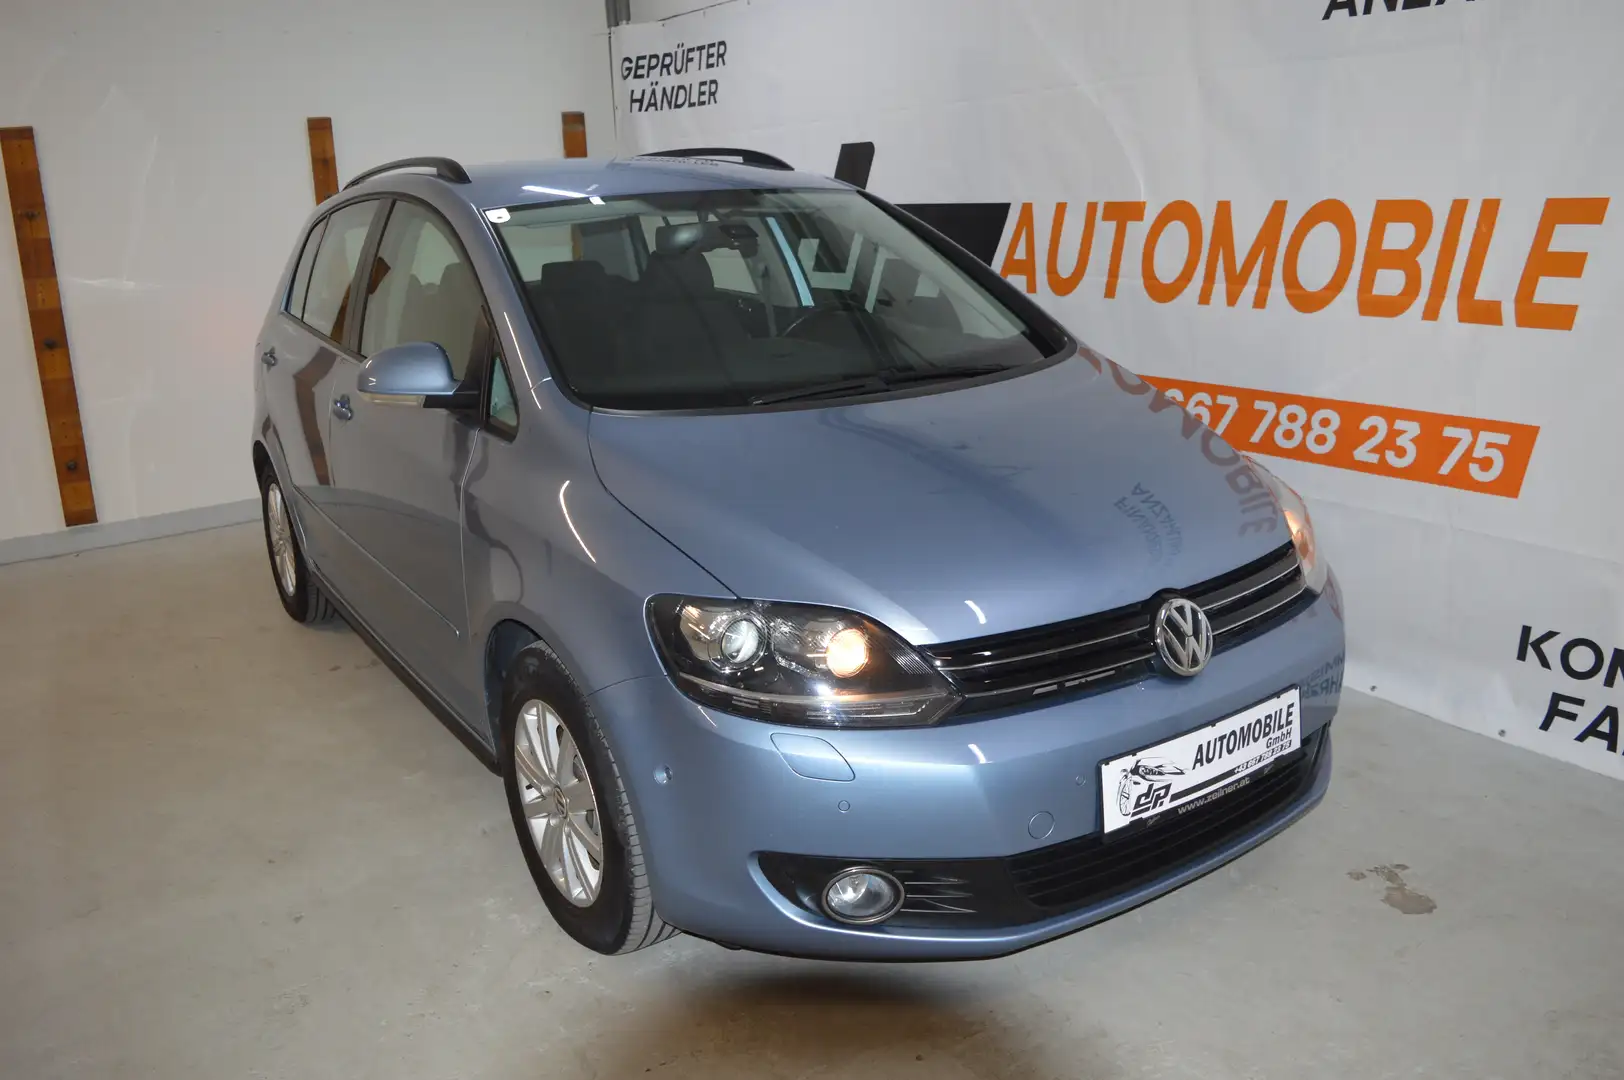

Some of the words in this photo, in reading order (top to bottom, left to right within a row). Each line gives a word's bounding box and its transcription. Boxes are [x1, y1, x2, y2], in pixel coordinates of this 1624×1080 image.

[620, 40, 727, 80] GEPRÜFTER
[629, 79, 719, 113] HÄNDLER
[1000, 197, 1610, 331] AUTOMOBILE
[1249, 400, 1341, 455] 788
[1353, 415, 1421, 468] 23
[1437, 426, 1511, 483] 75
[1192, 702, 1295, 770] AUTOMOBILE
[1266, 728, 1293, 749] GmbH
[1538, 692, 1624, 756] FA
